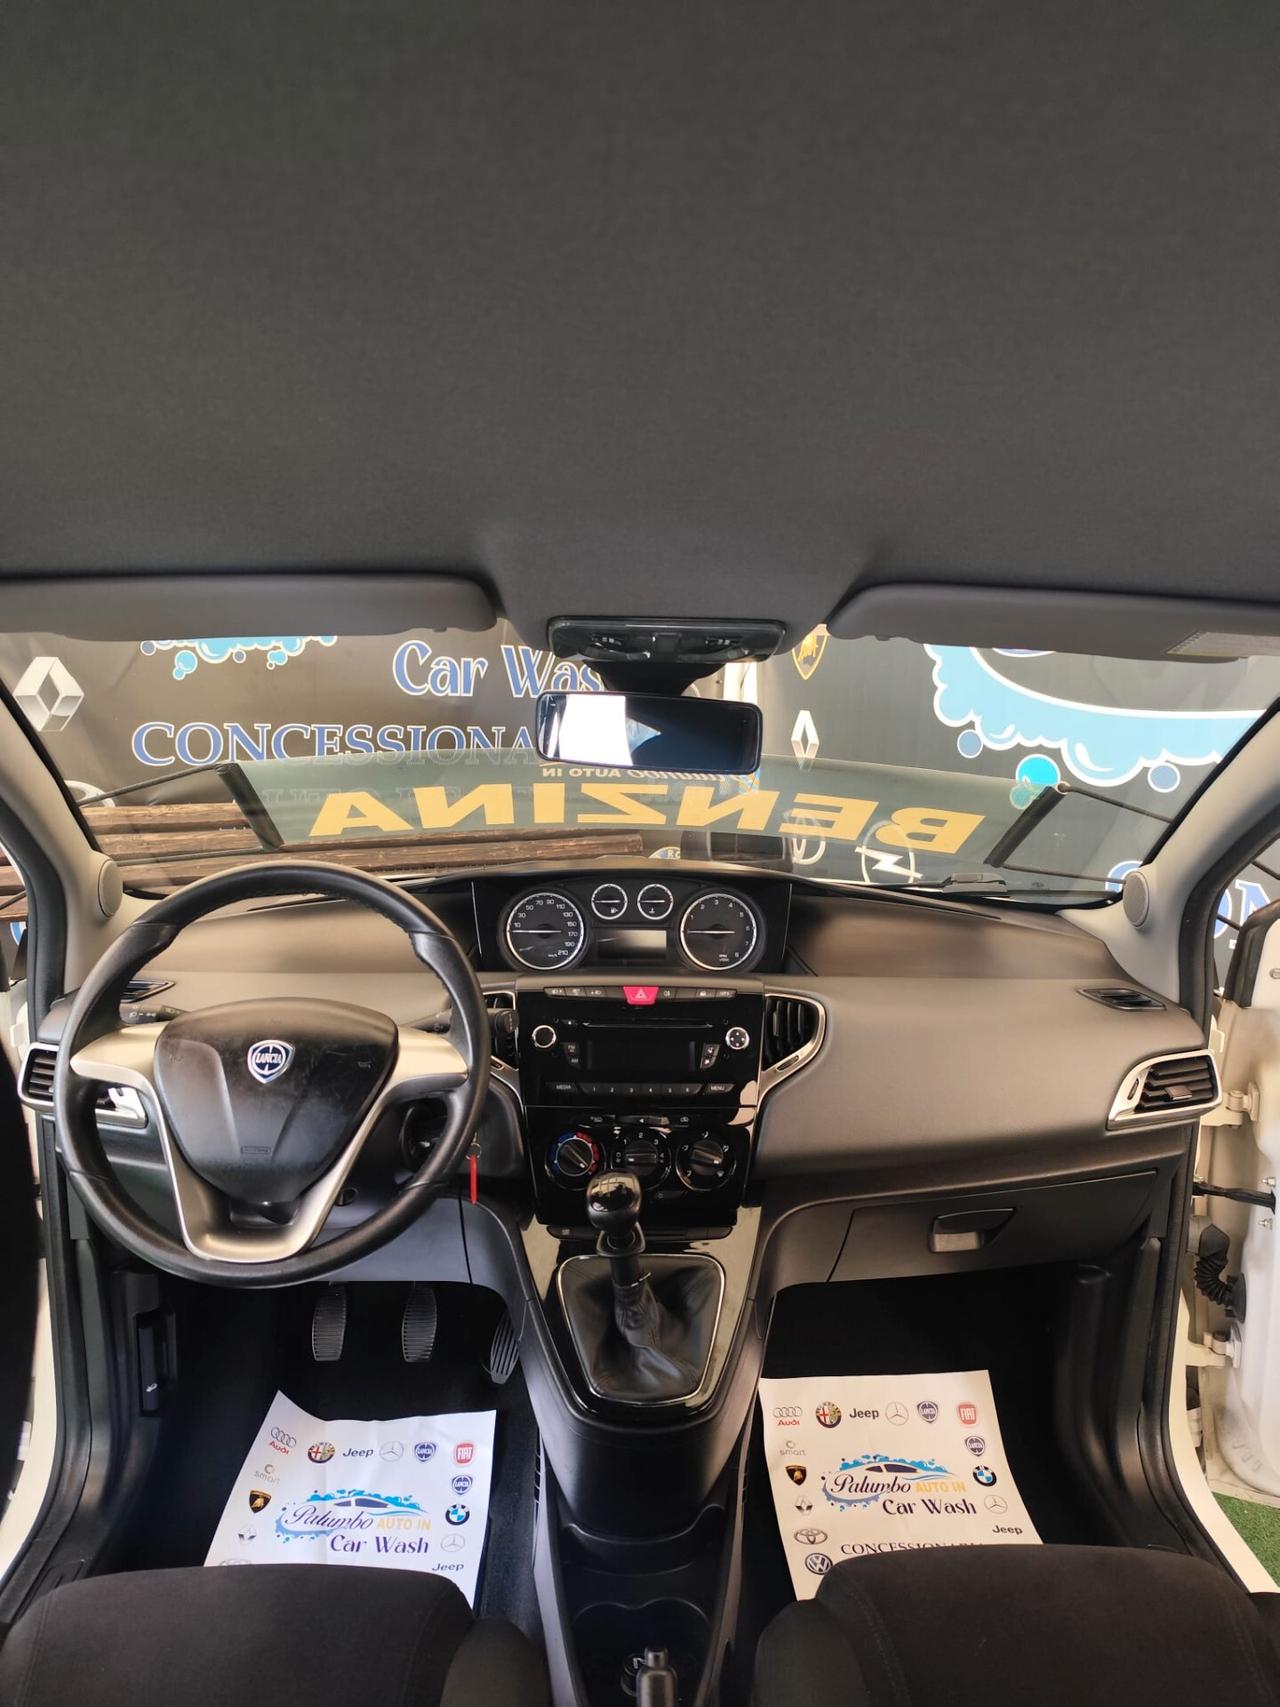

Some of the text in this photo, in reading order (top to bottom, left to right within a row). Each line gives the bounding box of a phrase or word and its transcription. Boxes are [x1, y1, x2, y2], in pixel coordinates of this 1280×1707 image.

[392, 639, 488, 697] Car
[255, 1053, 282, 1064] LANCIA
[849, 1408, 880, 1420] Jeep
[960, 1407, 975, 1421] FIAT
[268, 1440, 289, 1455] Audi
[342, 1447, 374, 1459] Jeep
[457, 1446, 472, 1460] FIAT
[830, 1473, 966, 1494] Palumbo AUTO IN
[882, 1498, 977, 1516] Car Wash
[285, 1505, 431, 1531] Palumbo AUTO IN
[992, 1525, 1023, 1535] Jeep
[330, 1534, 429, 1554] Car Wash
[432, 1562, 464, 1572] Jeep
